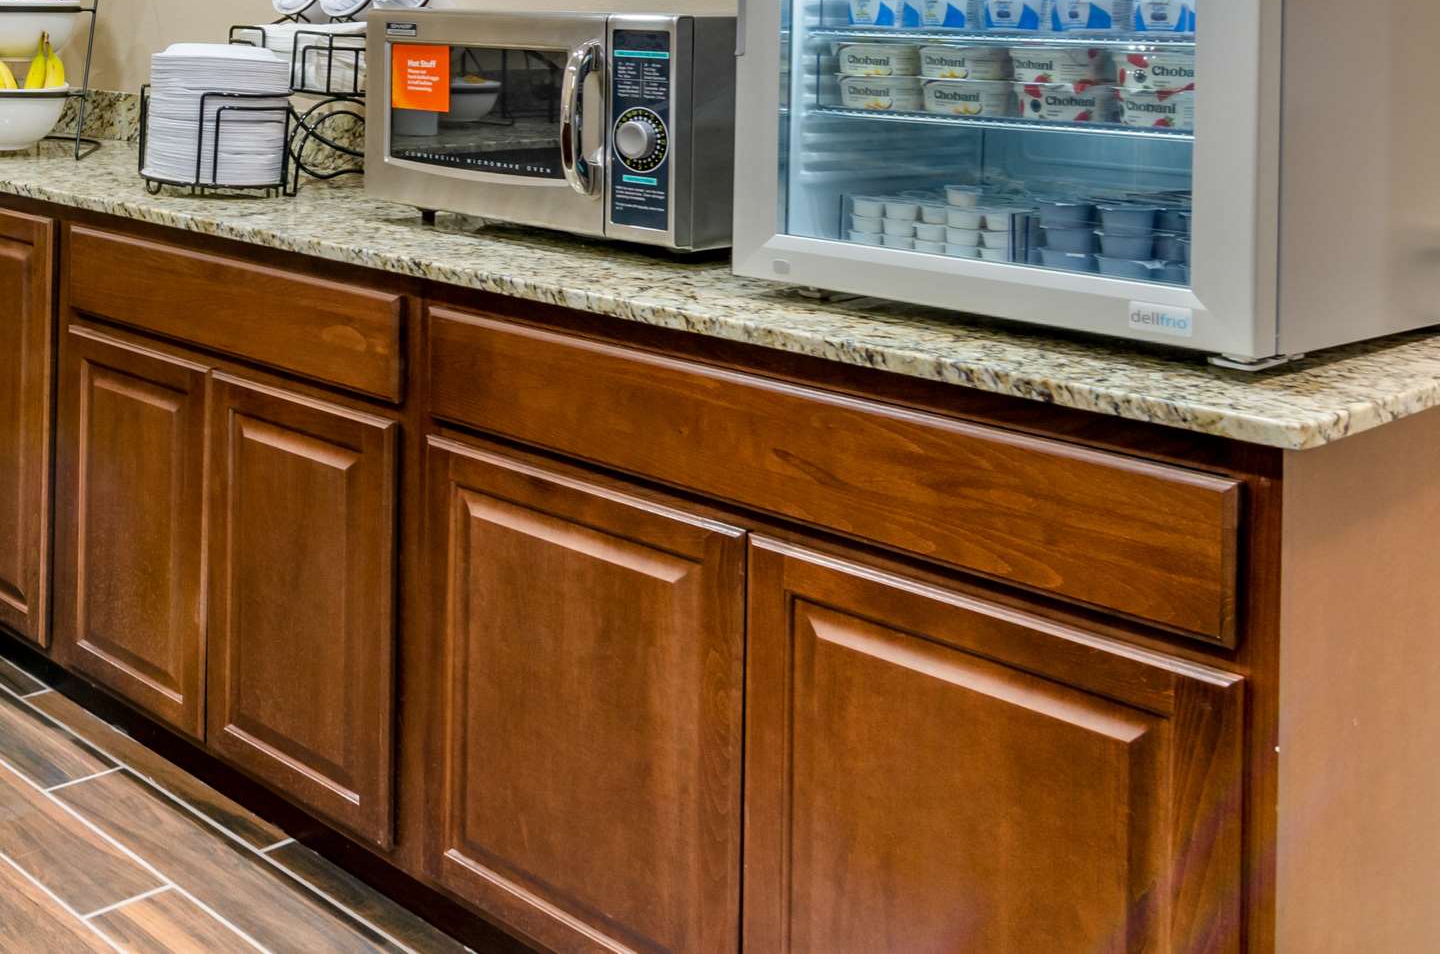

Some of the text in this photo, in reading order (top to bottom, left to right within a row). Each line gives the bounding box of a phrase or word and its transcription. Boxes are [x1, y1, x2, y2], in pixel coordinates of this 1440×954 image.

[407, 59, 437, 69] Hot Stuff
[847, 54, 890, 67] Chobani
[925, 55, 966, 68] Chobani
[1151, 65, 1194, 78] Choba
[847, 84, 890, 97] Chobani
[934, 89, 980, 103] Chobani
[1044, 96, 1096, 108] Chobani
[1126, 100, 1177, 115] Chobani
[404, 150, 552, 174] COMMERCIAL MICROWAVE OVEN
[1130, 310, 1188, 329] dellfrio
